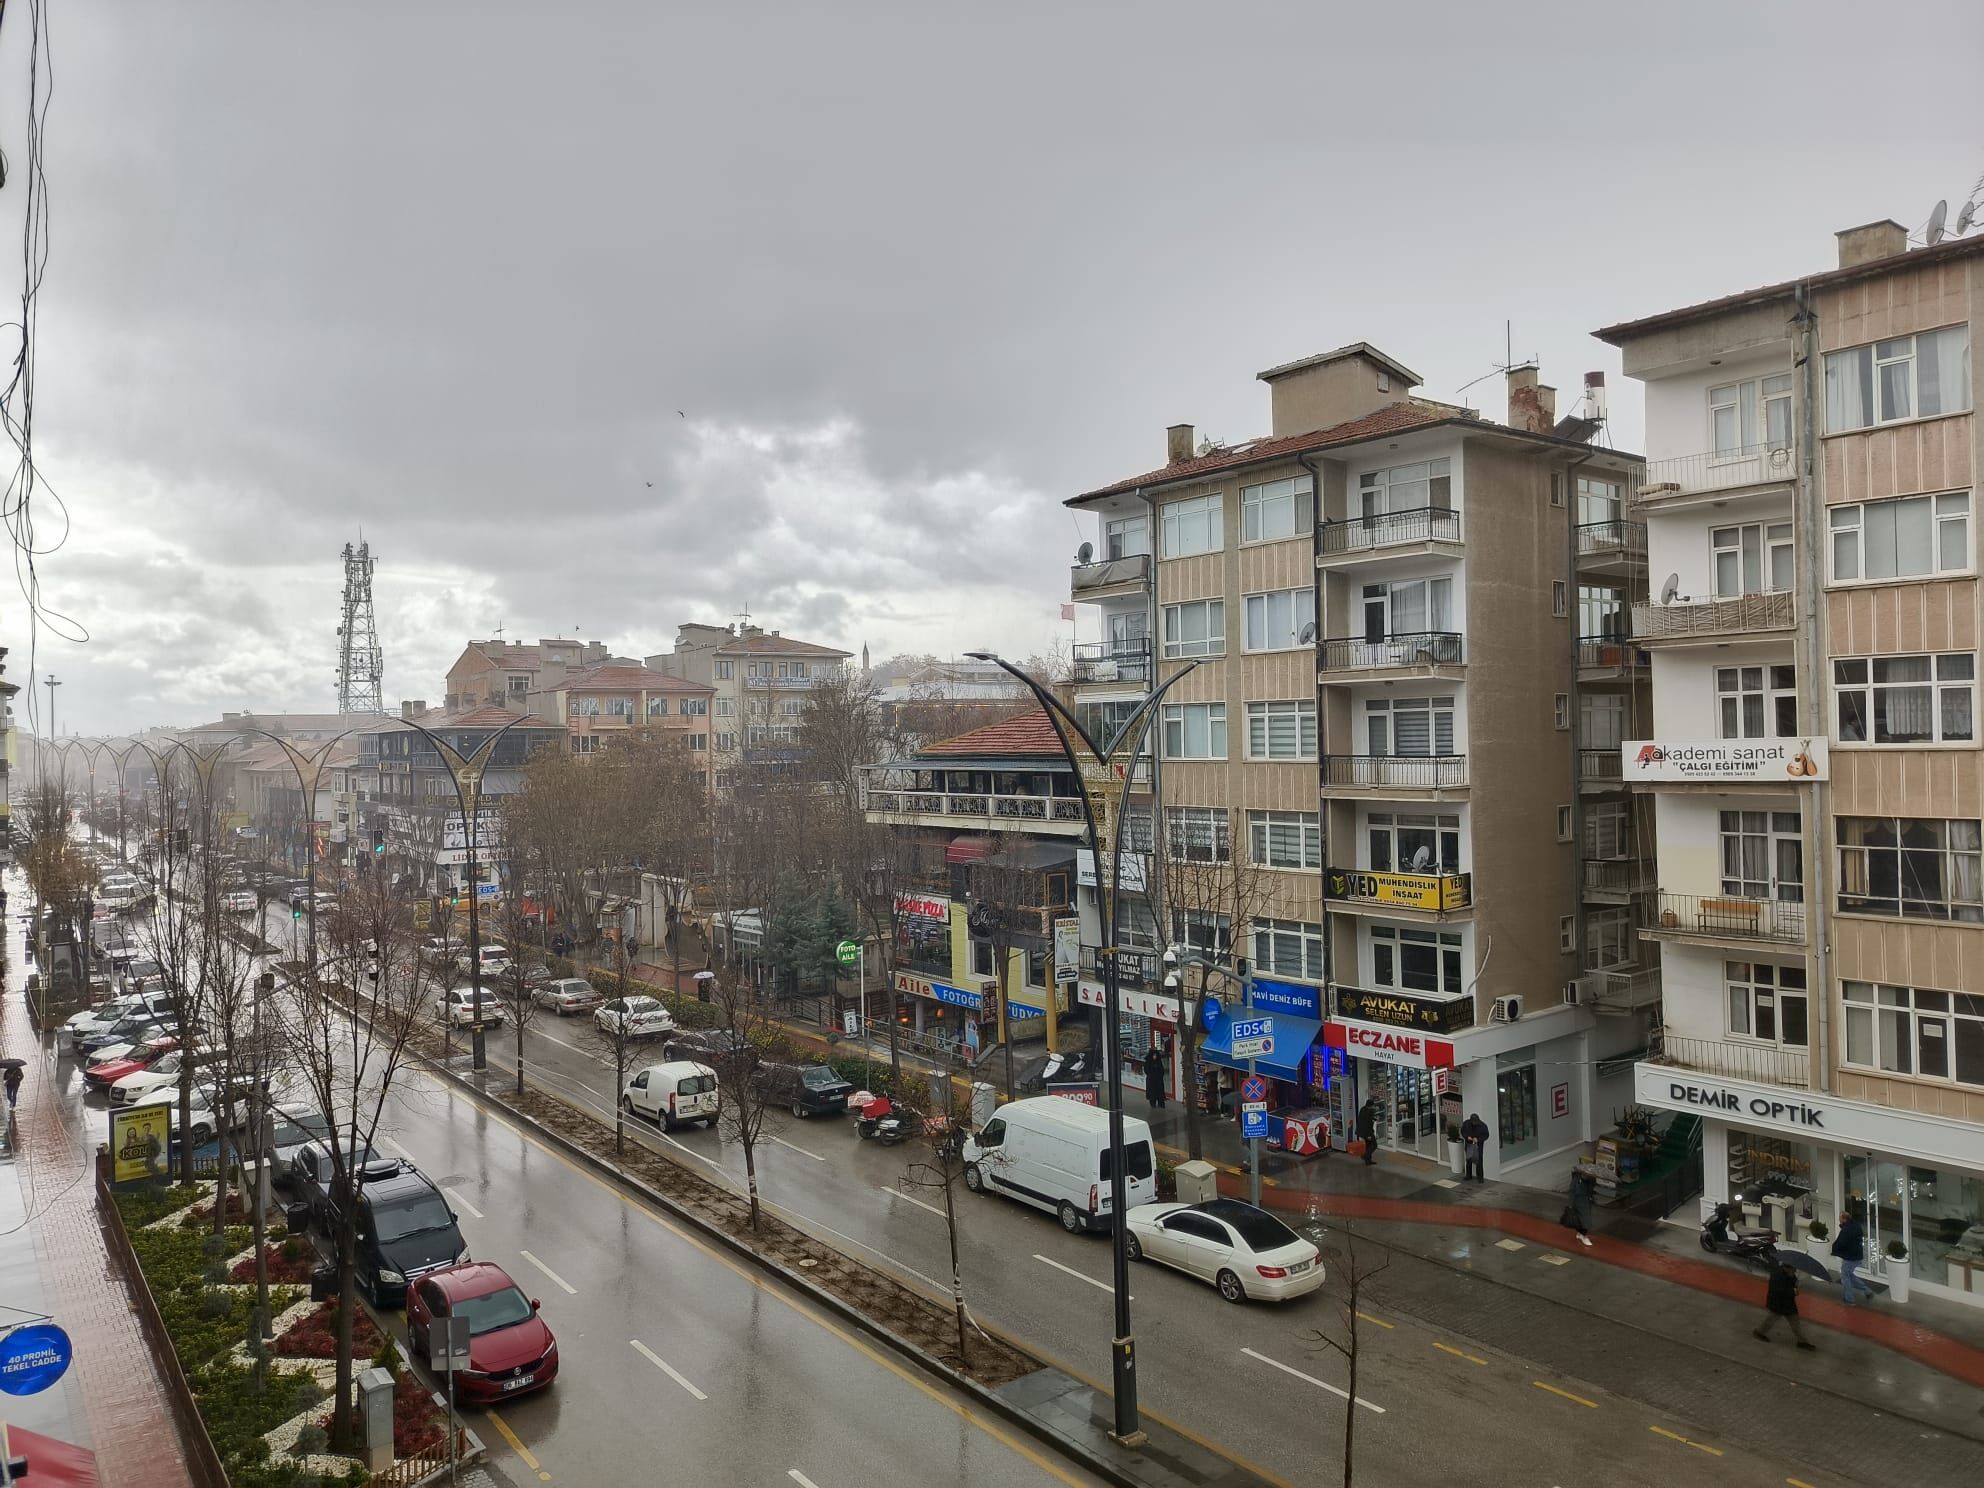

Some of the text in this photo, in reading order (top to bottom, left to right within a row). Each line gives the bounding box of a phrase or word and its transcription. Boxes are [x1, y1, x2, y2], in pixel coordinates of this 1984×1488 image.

[1651, 745, 1785, 760] akademi sanat
[1346, 873, 1378, 897] YED
[1449, 877, 1463, 890] YED
[840, 945, 856, 953] FOTO
[841, 953, 855, 961] AİLE
[1119, 964, 1141, 975] YILMAZ
[898, 976, 930, 995] Aile
[1082, 988, 1168, 1017] SALIK
[1269, 993, 1291, 1004] DENİZ
[1292, 997, 1313, 1008] BÜFE
[1360, 995, 1416, 1014] AVUKAT
[1365, 1007, 1389, 1018] SELEN
[1391, 1012, 1413, 1022] UZUN
[1235, 1022, 1259, 1037] EDS
[1349, 1027, 1421, 1055] ECZANE
[1374, 1050, 1395, 1060] HAYAT
[1438, 1074, 1444, 1090] E
[1554, 1089, 1565, 1112] E
[1670, 1083, 1824, 1128] DEMİR OPTİK
[1747, 1146, 1811, 1171] İNDİRİM
[2, 1354, 62, 1373] TEKEL CADDE
[8, 1346, 57, 1364] 40 PROMİL
